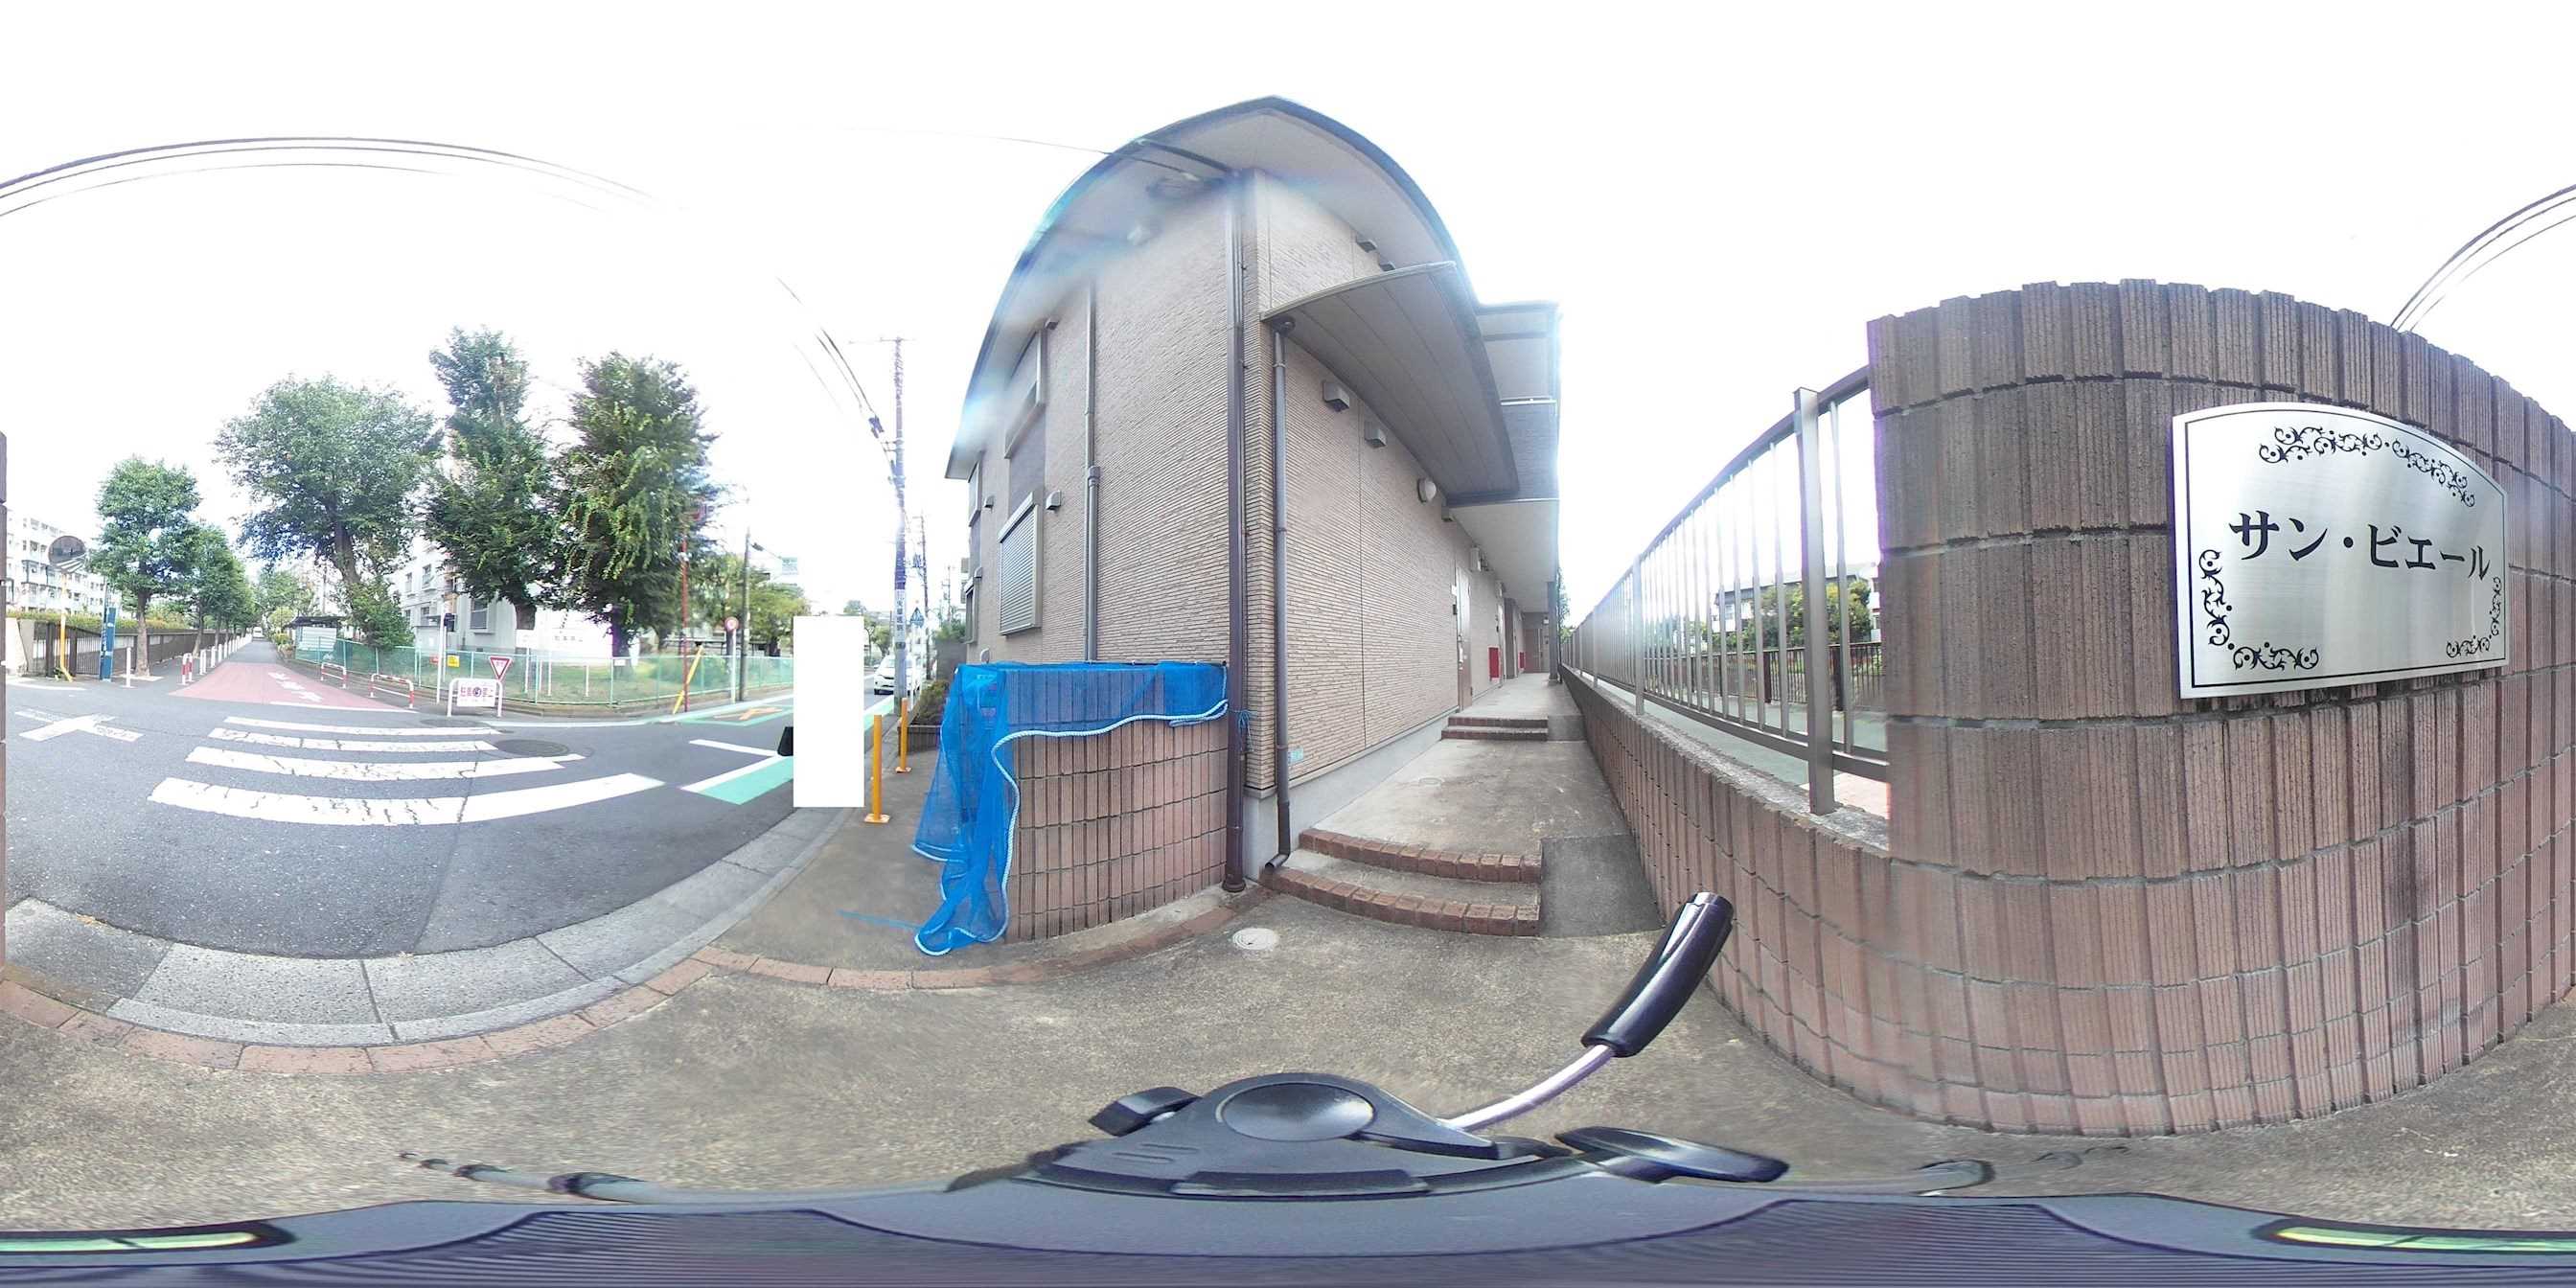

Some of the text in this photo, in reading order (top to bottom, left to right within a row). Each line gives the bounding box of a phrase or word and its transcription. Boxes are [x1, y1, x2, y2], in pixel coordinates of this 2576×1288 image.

[2228, 510, 2491, 581] サン・ビエール
